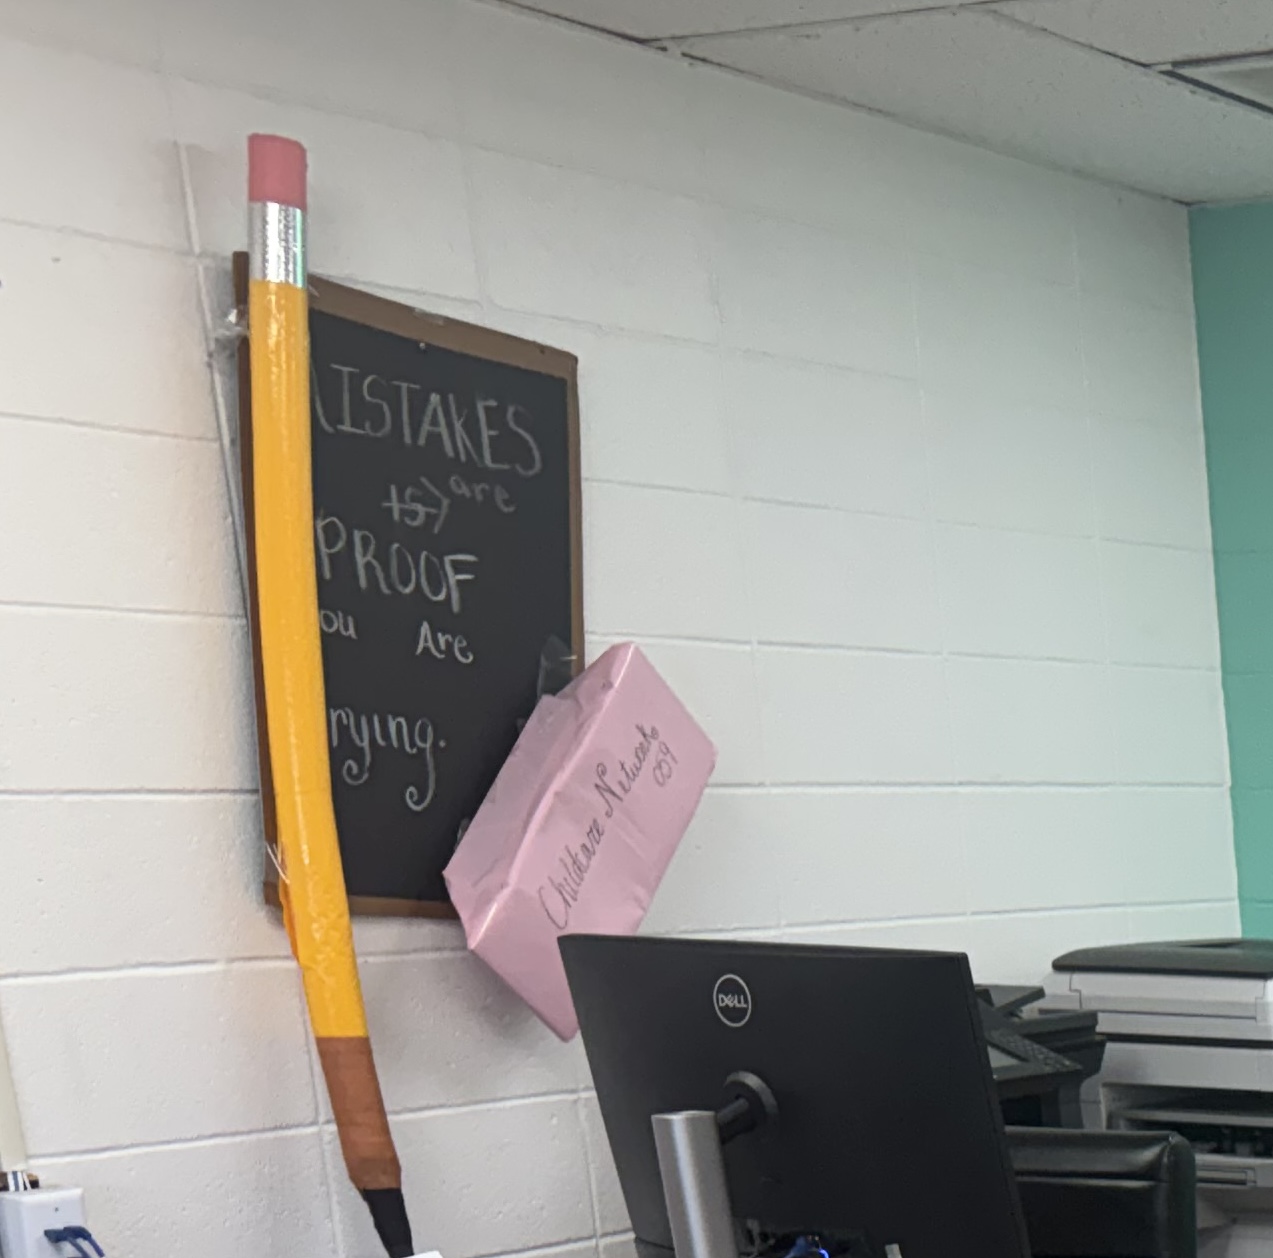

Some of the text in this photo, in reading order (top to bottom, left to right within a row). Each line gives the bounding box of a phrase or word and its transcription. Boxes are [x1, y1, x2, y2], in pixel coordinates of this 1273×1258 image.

[449, 473, 517, 514] are
[316, 514, 479, 614] PROOF
[319, 609, 359, 640] ou
[415, 620, 475, 665] Are
[329, 706, 448, 812] rying.
[718, 993, 748, 1008] DELL
